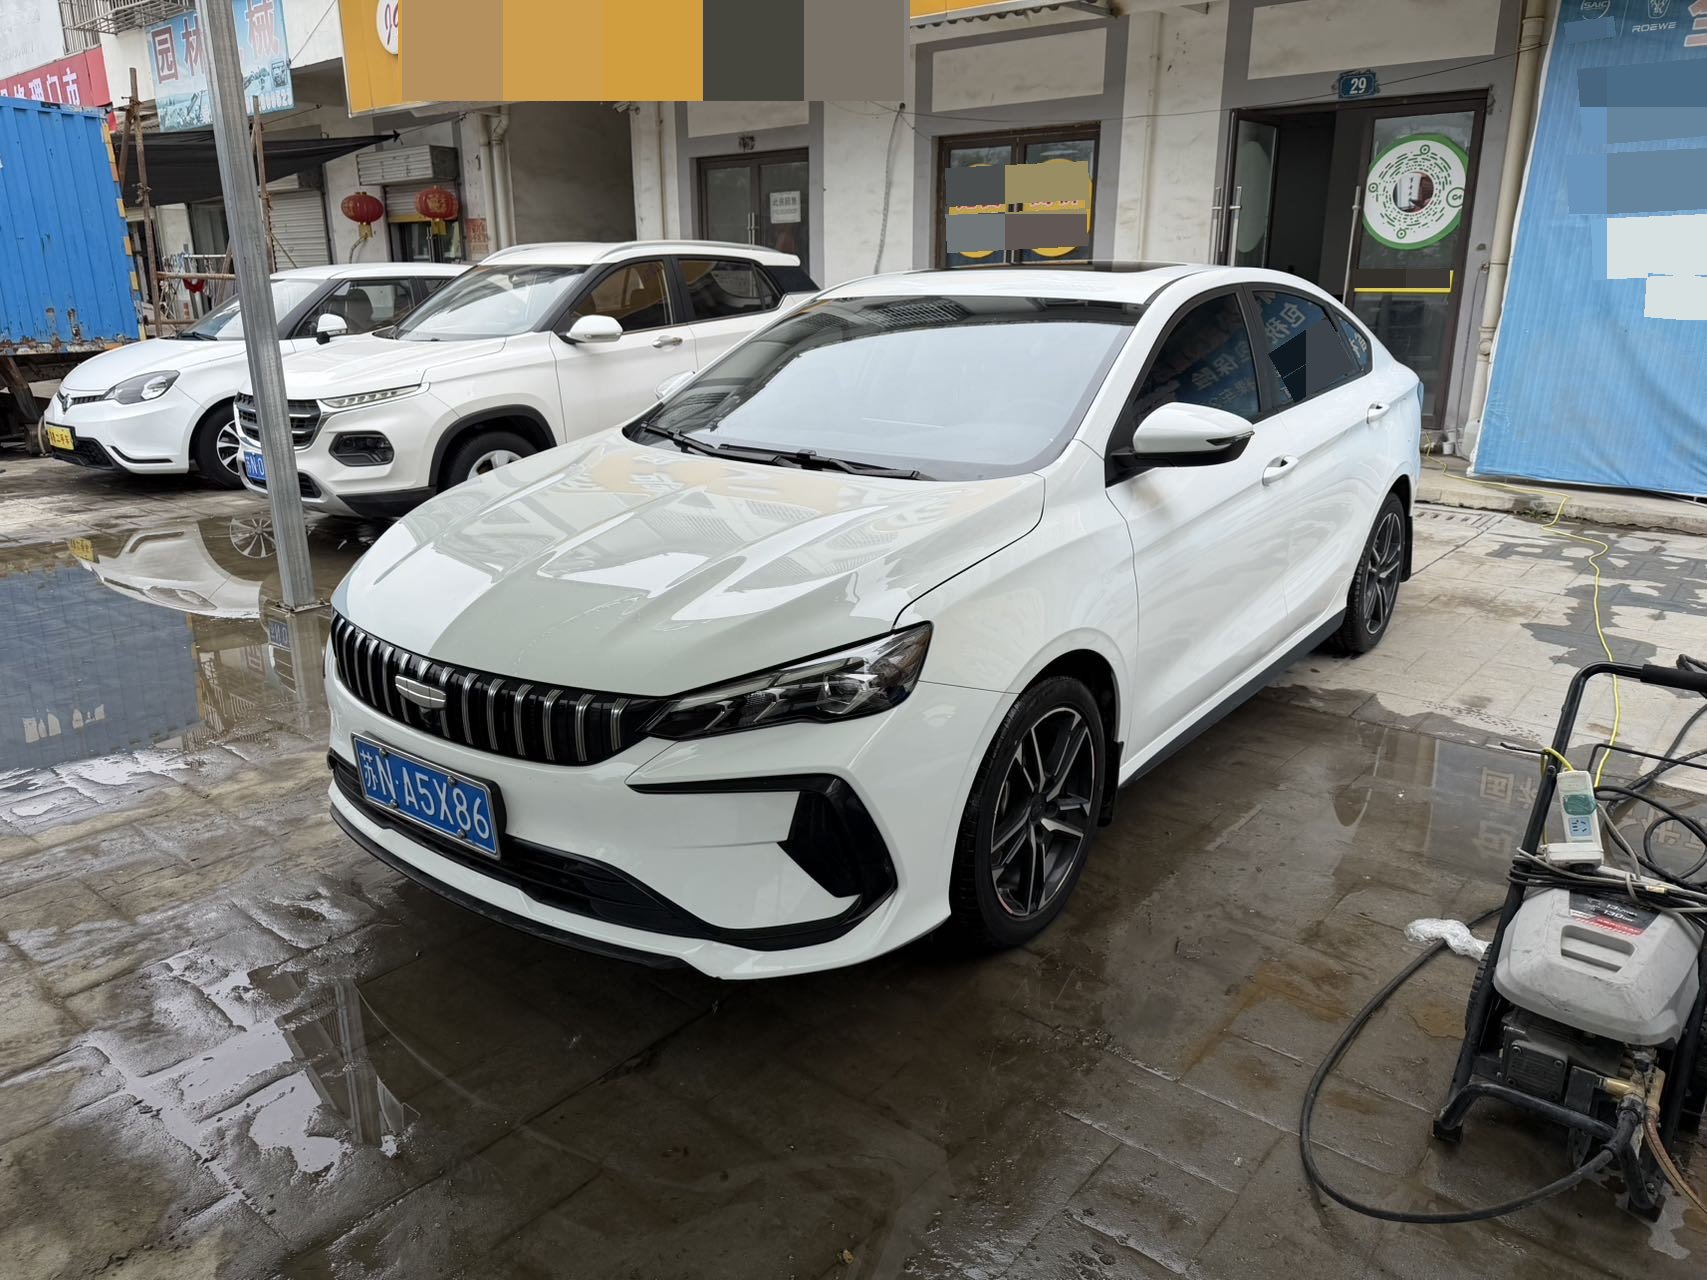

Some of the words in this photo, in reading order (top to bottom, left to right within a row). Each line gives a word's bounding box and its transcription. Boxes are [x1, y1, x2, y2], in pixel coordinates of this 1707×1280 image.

[1583, 0, 1608, 8] SAIC
[1632, 22, 1677, 32] ROEWE
[150, 0, 279, 84] 园林械
[0, 67, 80, 105] 理门市
[1350, 77, 1367, 94] 29
